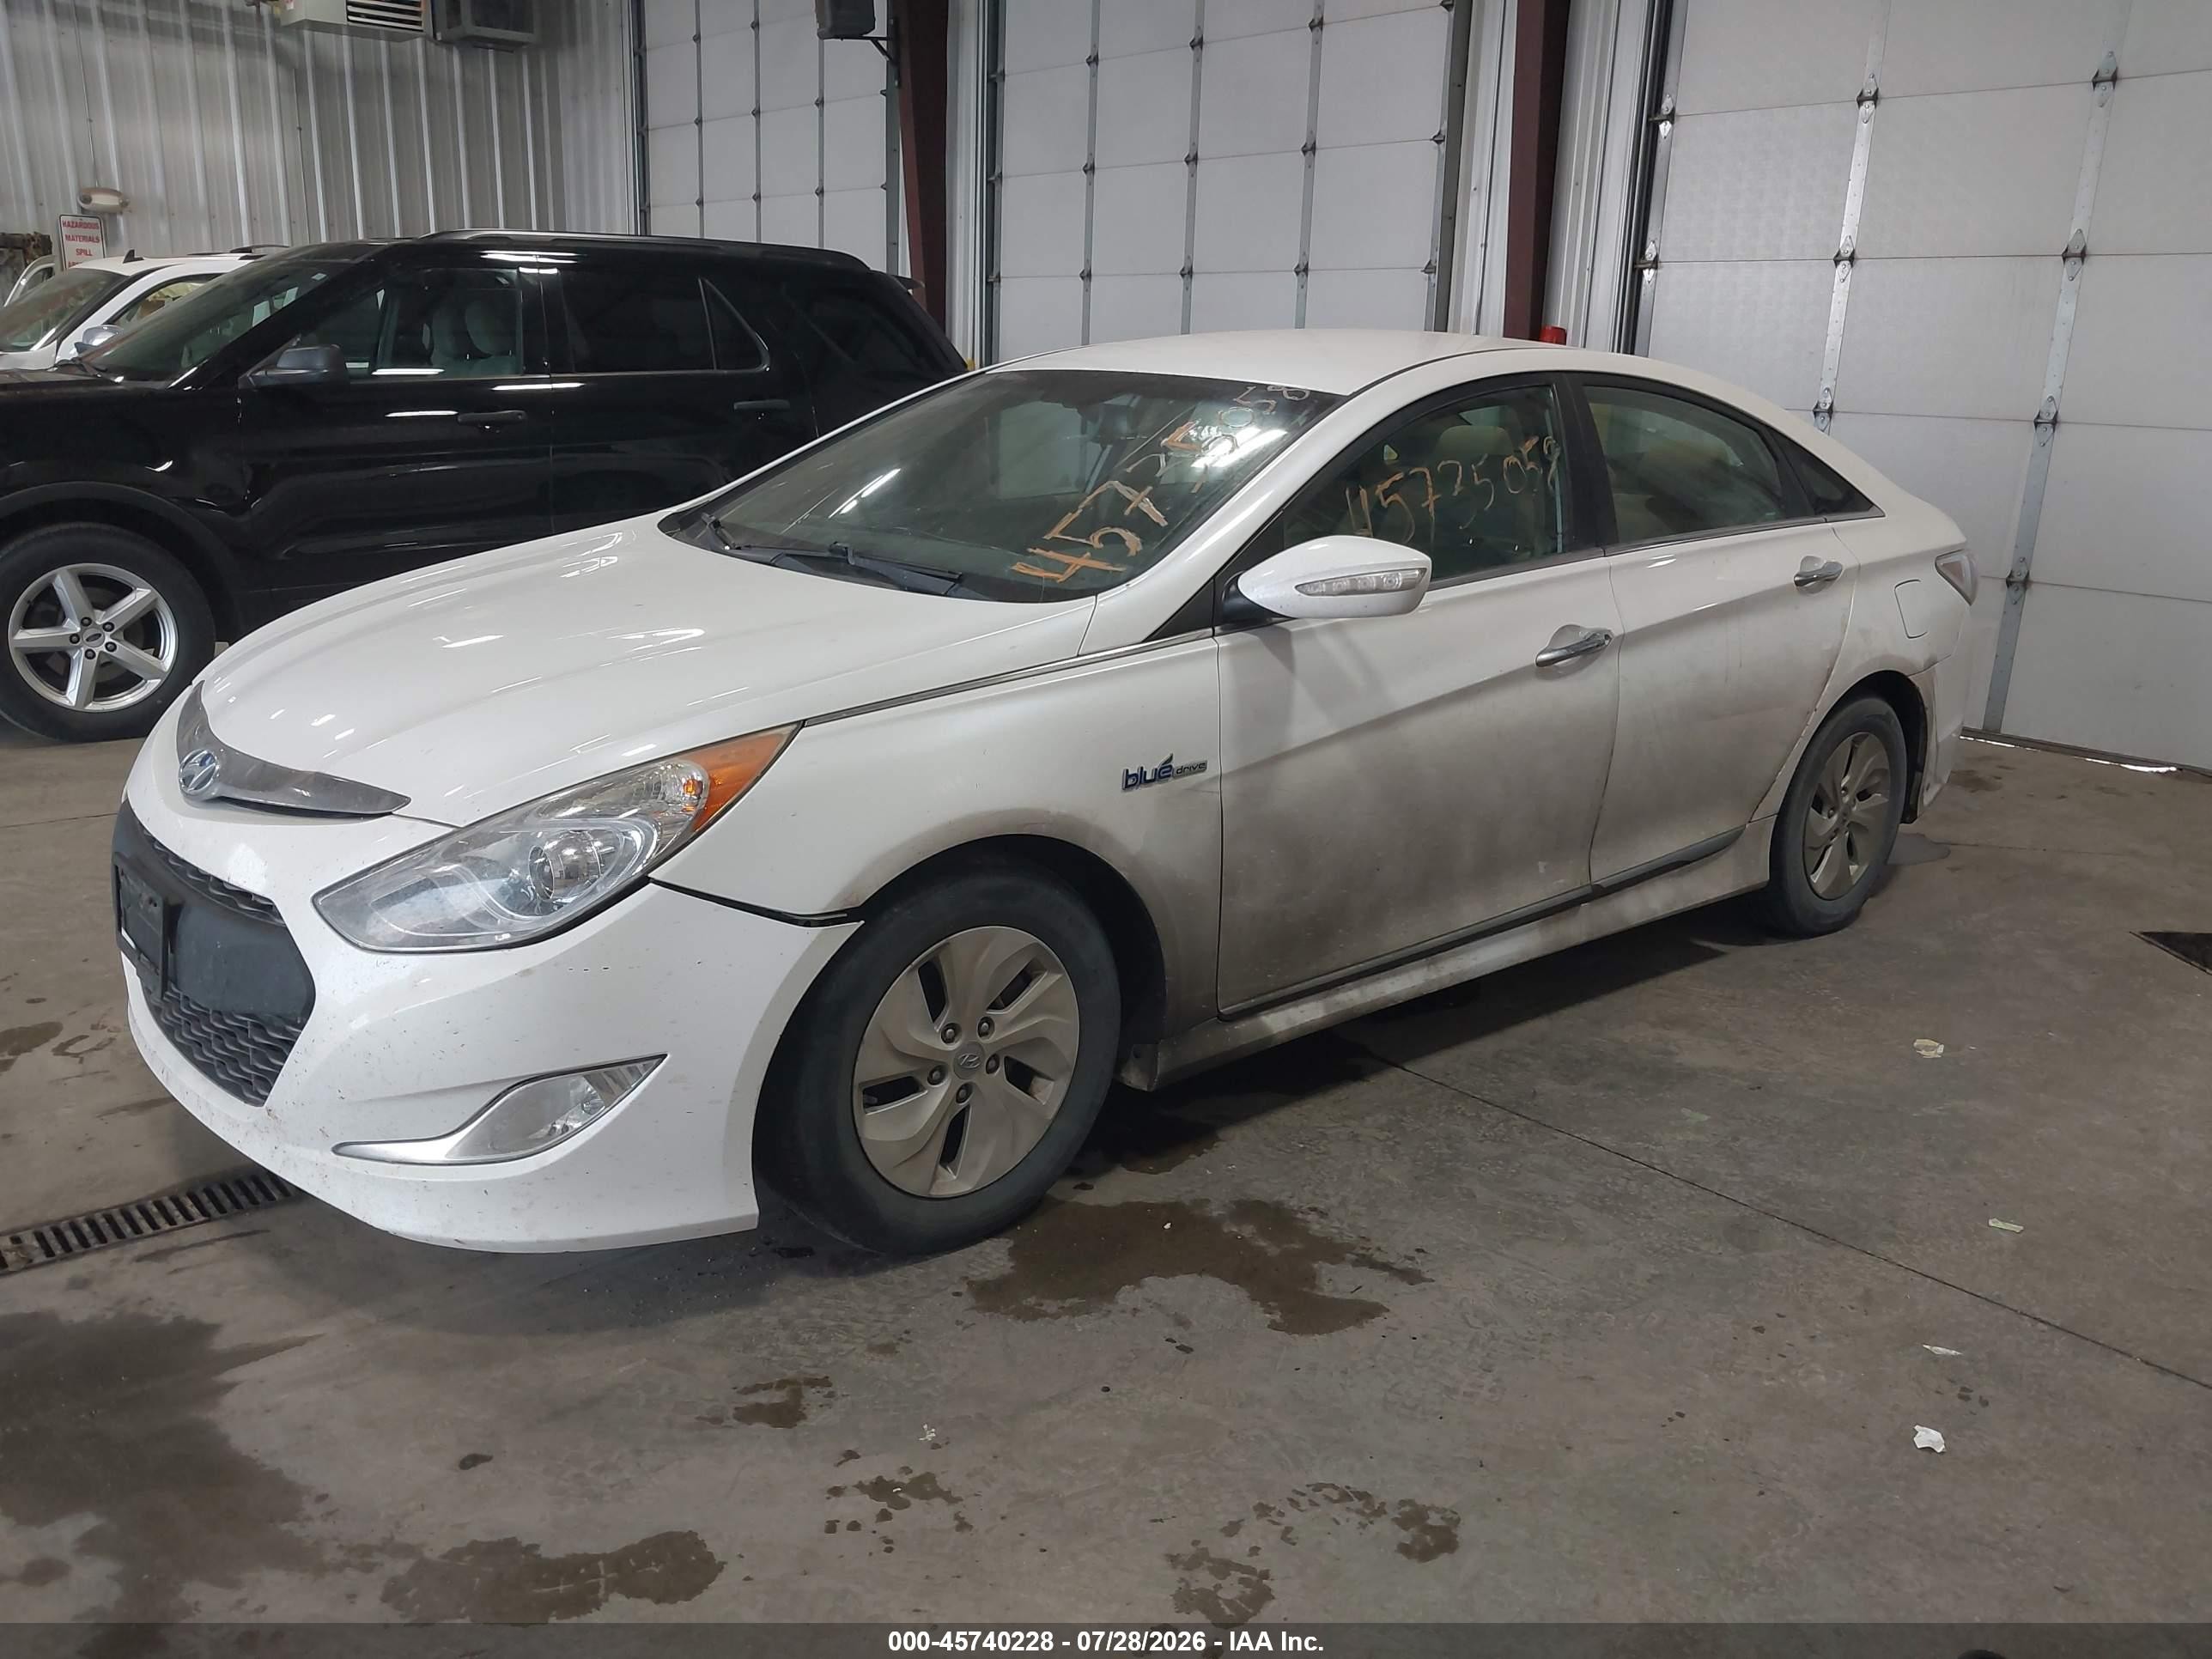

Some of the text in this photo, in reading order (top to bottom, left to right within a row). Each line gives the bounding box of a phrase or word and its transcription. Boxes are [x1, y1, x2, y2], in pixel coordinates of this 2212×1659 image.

[63, 220, 100, 229] HAZARDOUS
[65, 234, 100, 243] MATERIALS
[1176, 762, 1206, 775] drive
